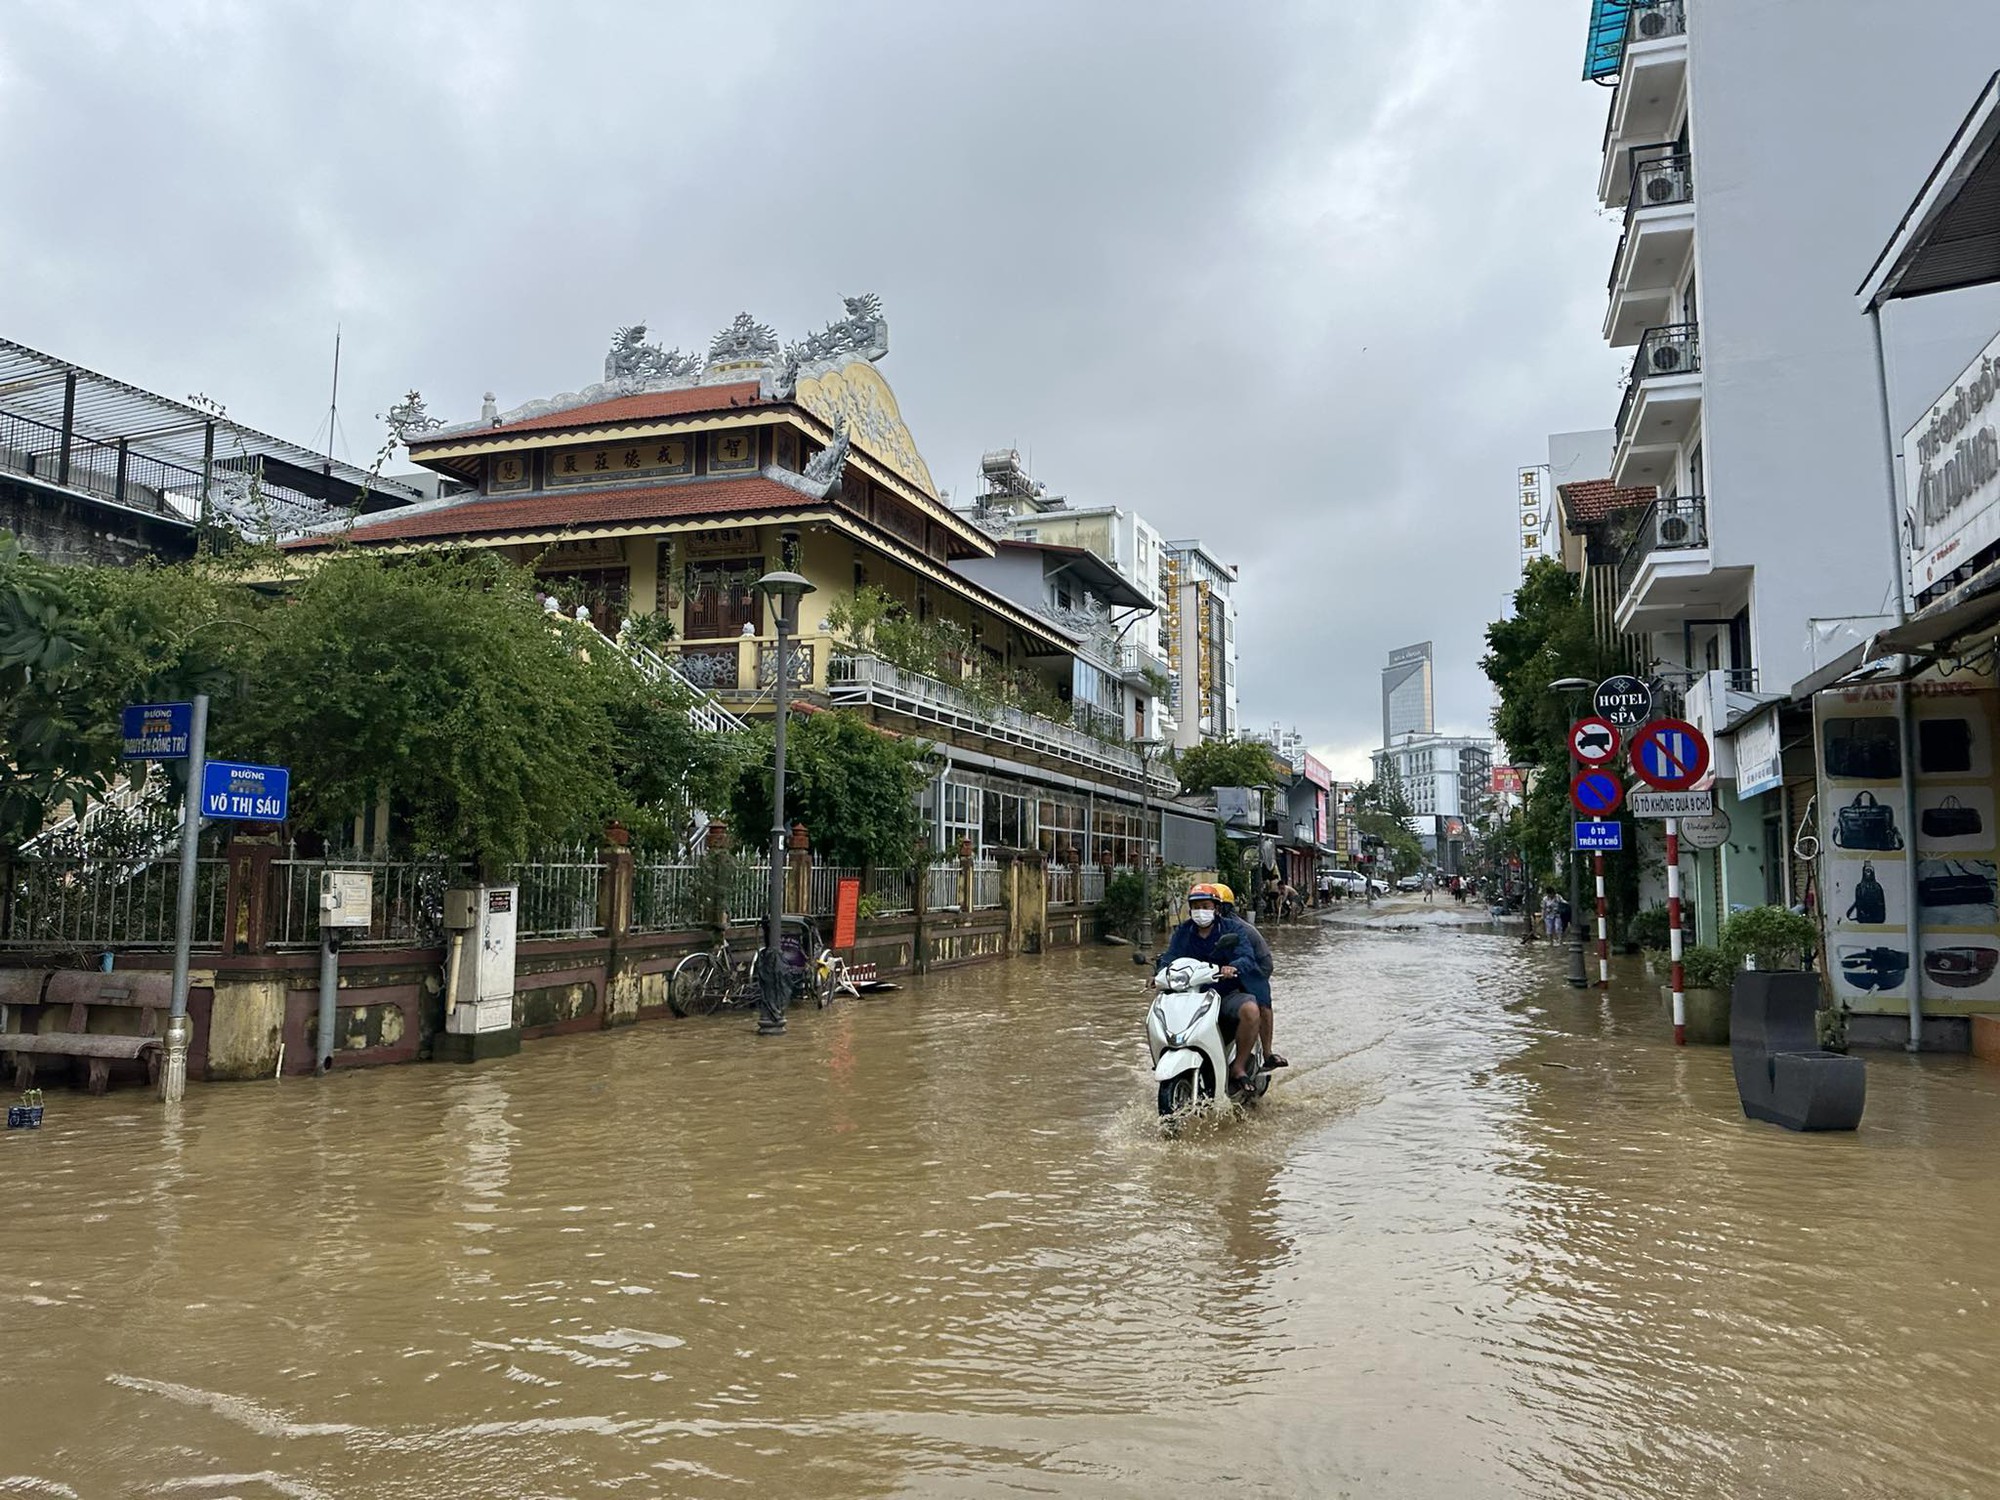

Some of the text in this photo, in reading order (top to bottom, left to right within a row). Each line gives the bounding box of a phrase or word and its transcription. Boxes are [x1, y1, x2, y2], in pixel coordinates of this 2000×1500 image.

[1599, 693, 1647, 707] HOTEL
[1610, 711, 1636, 724] SPA
[152, 734, 171, 753] CÔNG
[230, 769, 265, 780] ĐƯỜNG
[210, 793, 280, 816] VÕ THỊ SÁU
[1634, 793, 1711, 812] Ô TÔ KHÔNG QUÁ 9 CHỖ
[1590, 825, 1606, 835] Ô TÔ
[1579, 834, 1618, 846] TRÊN 9 CHỖ
